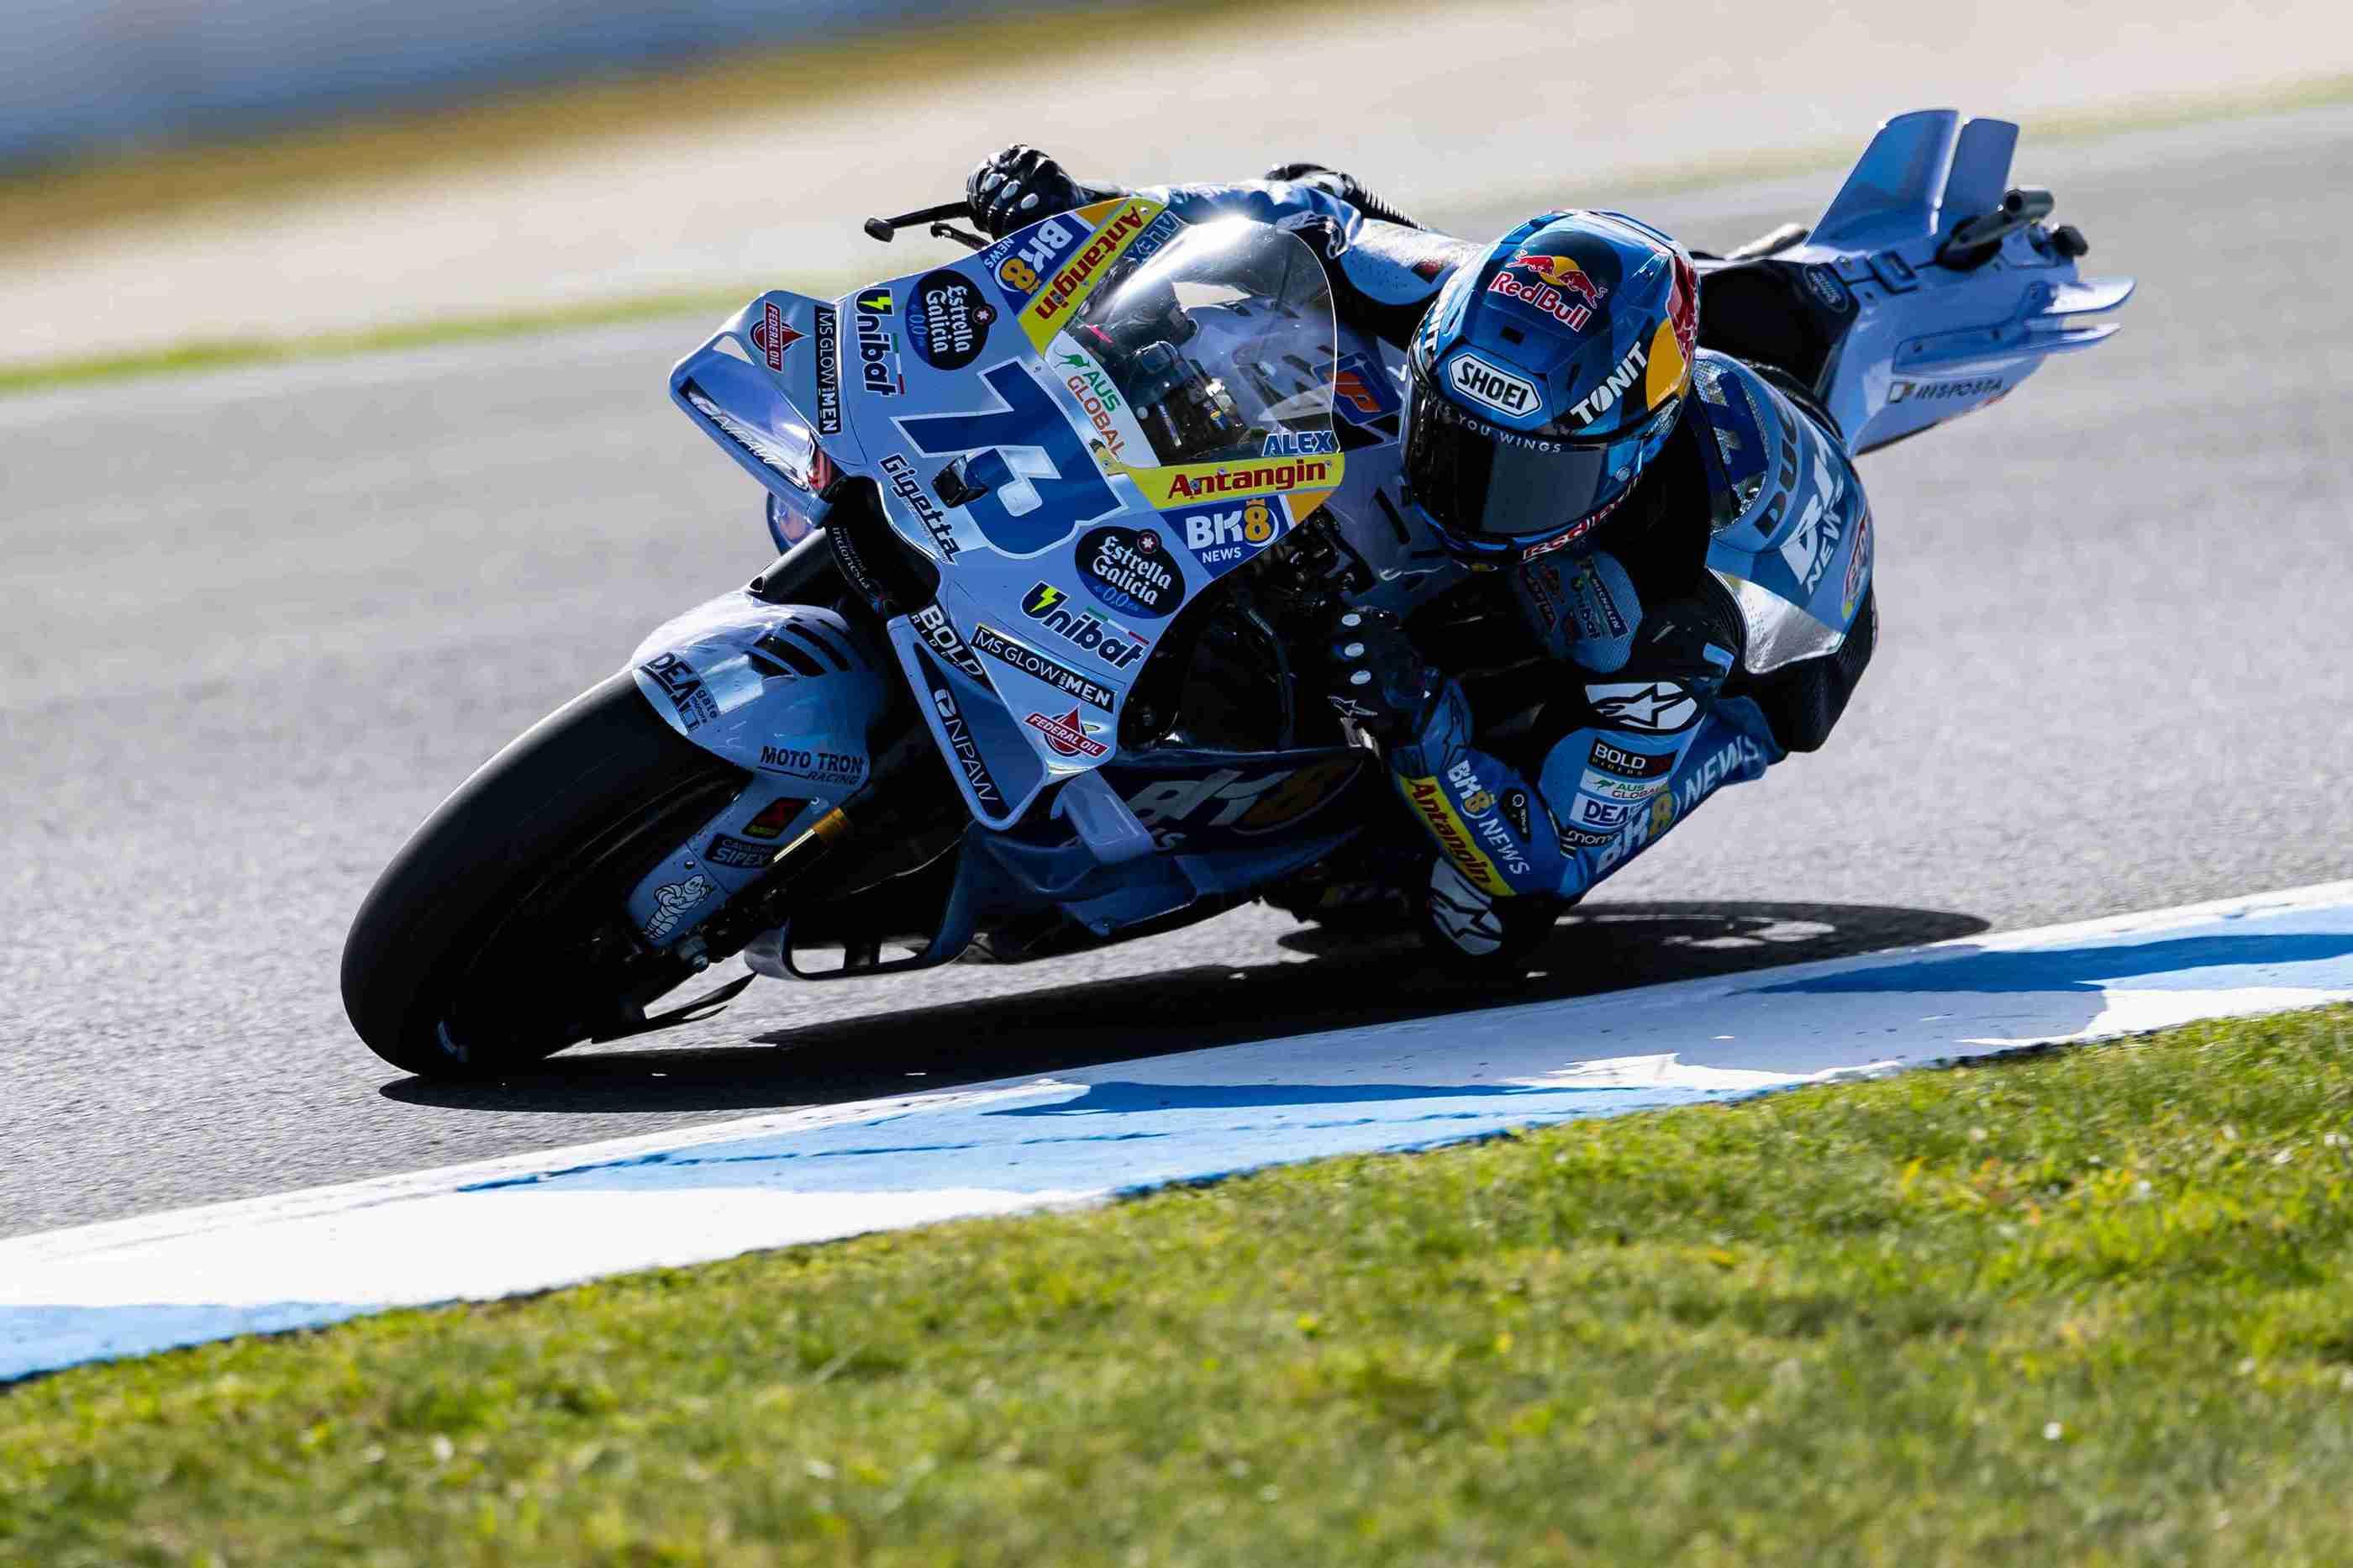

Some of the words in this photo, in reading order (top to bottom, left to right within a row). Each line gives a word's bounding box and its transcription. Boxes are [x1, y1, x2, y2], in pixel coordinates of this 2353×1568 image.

[983, 237, 1014, 269] NEWS
[996, 219, 1074, 294] BK8
[1034, 206, 1144, 320] Antangin
[766, 305, 781, 350] FEDERAL
[817, 310, 835, 338] MS
[855, 287, 898, 397] Unibat
[925, 288, 953, 354] Galicia
[947, 285, 975, 352] Estrella
[768, 350, 782, 371] OIL
[819, 338, 837, 386] GLOW
[1082, 370, 1121, 413] AUS
[1457, 360, 1529, 412] SHOEI
[1067, 376, 1128, 459] GLOBAL
[1458, 413, 1492, 437] YOU
[1498, 432, 1561, 453] WINGS
[1262, 429, 1334, 458] ALEX
[1168, 459, 1327, 499] Antangin
[1186, 502, 1272, 550] BK8
[1097, 535, 1172, 590] Estrella
[1202, 547, 1242, 564] NEWS
[1092, 555, 1159, 606] Galicia
[918, 603, 985, 677] BOLD
[1021, 581, 1146, 669] Unibat
[976, 629, 1003, 655] MS
[1005, 644, 1060, 681] GLOW
[1030, 715, 1080, 746] FEDERAL
[1080, 739, 1100, 755] OIL
[1594, 743, 1646, 770] BOLD
[760, 745, 812, 769] MOTO
[818, 753, 864, 774] TRON
[808, 771, 861, 787] RACING
[1683, 736, 1761, 811] NEWS
[1614, 783, 1645, 792] AUS
[1412, 784, 1492, 883] Antangin
[1446, 759, 1492, 814] BK8
[1479, 818, 1531, 876] NEWS
